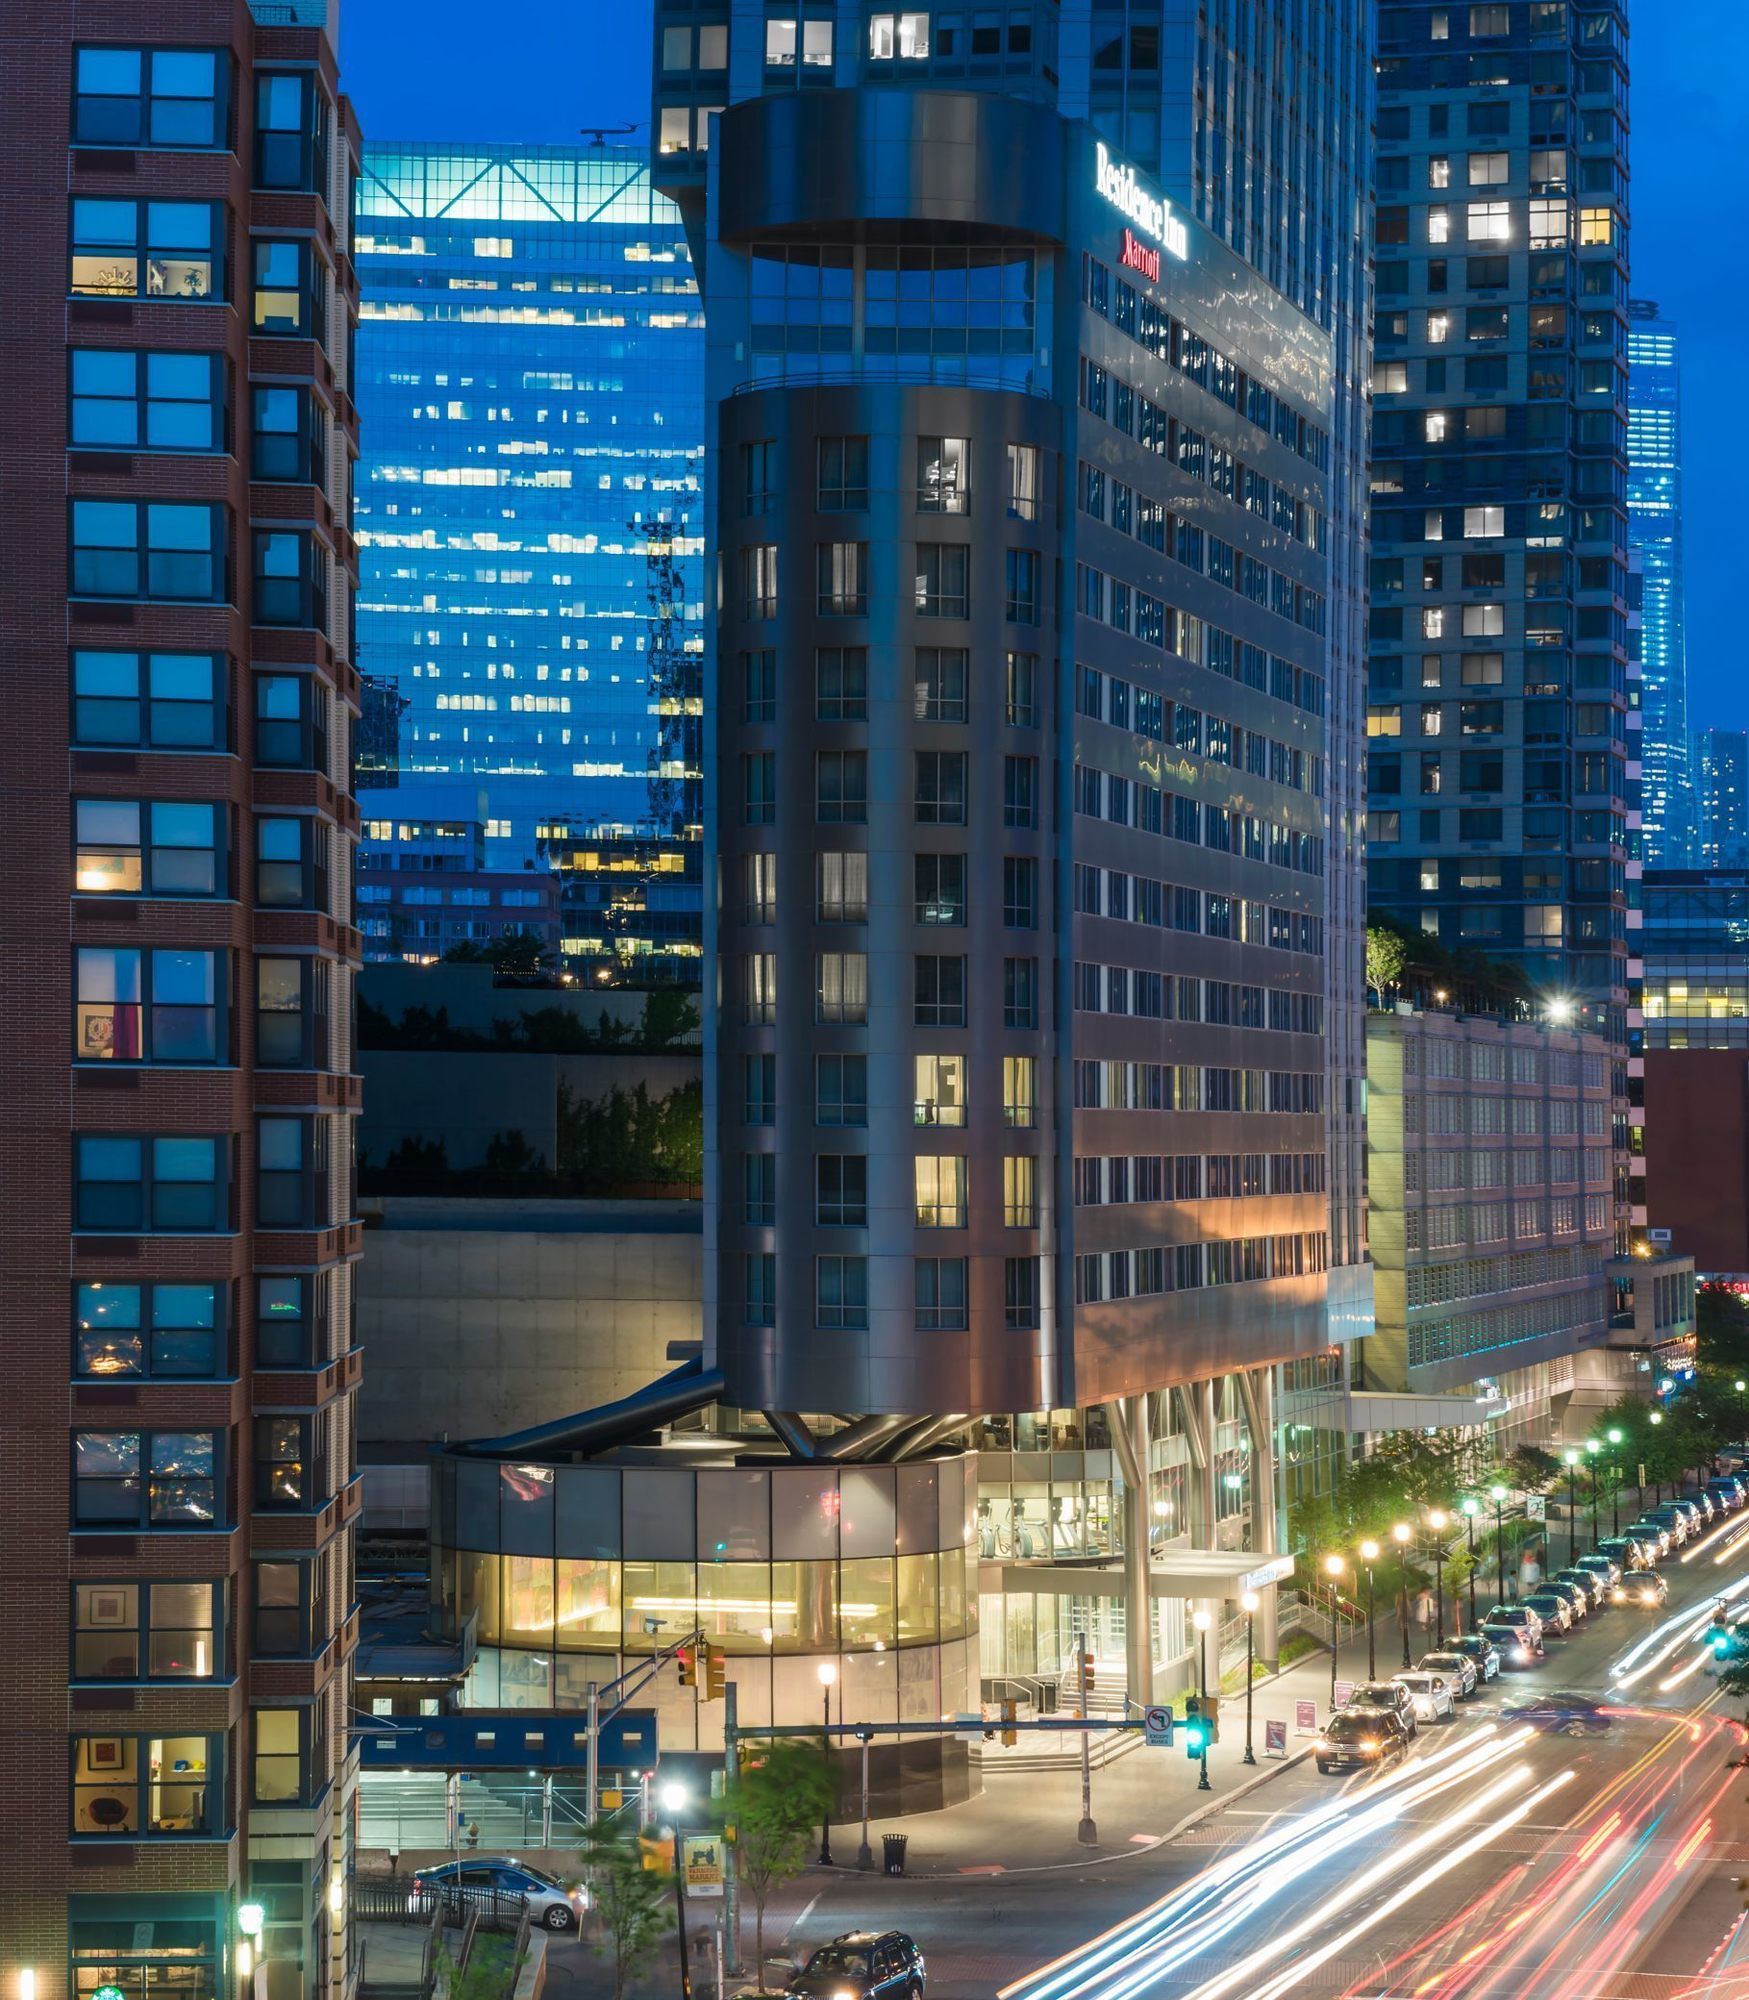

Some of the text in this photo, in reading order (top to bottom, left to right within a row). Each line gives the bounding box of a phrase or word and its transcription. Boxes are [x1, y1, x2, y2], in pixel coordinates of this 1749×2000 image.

[1097, 142, 1187, 261] Residence Inn
[1122, 228, 1160, 283] Marriott
